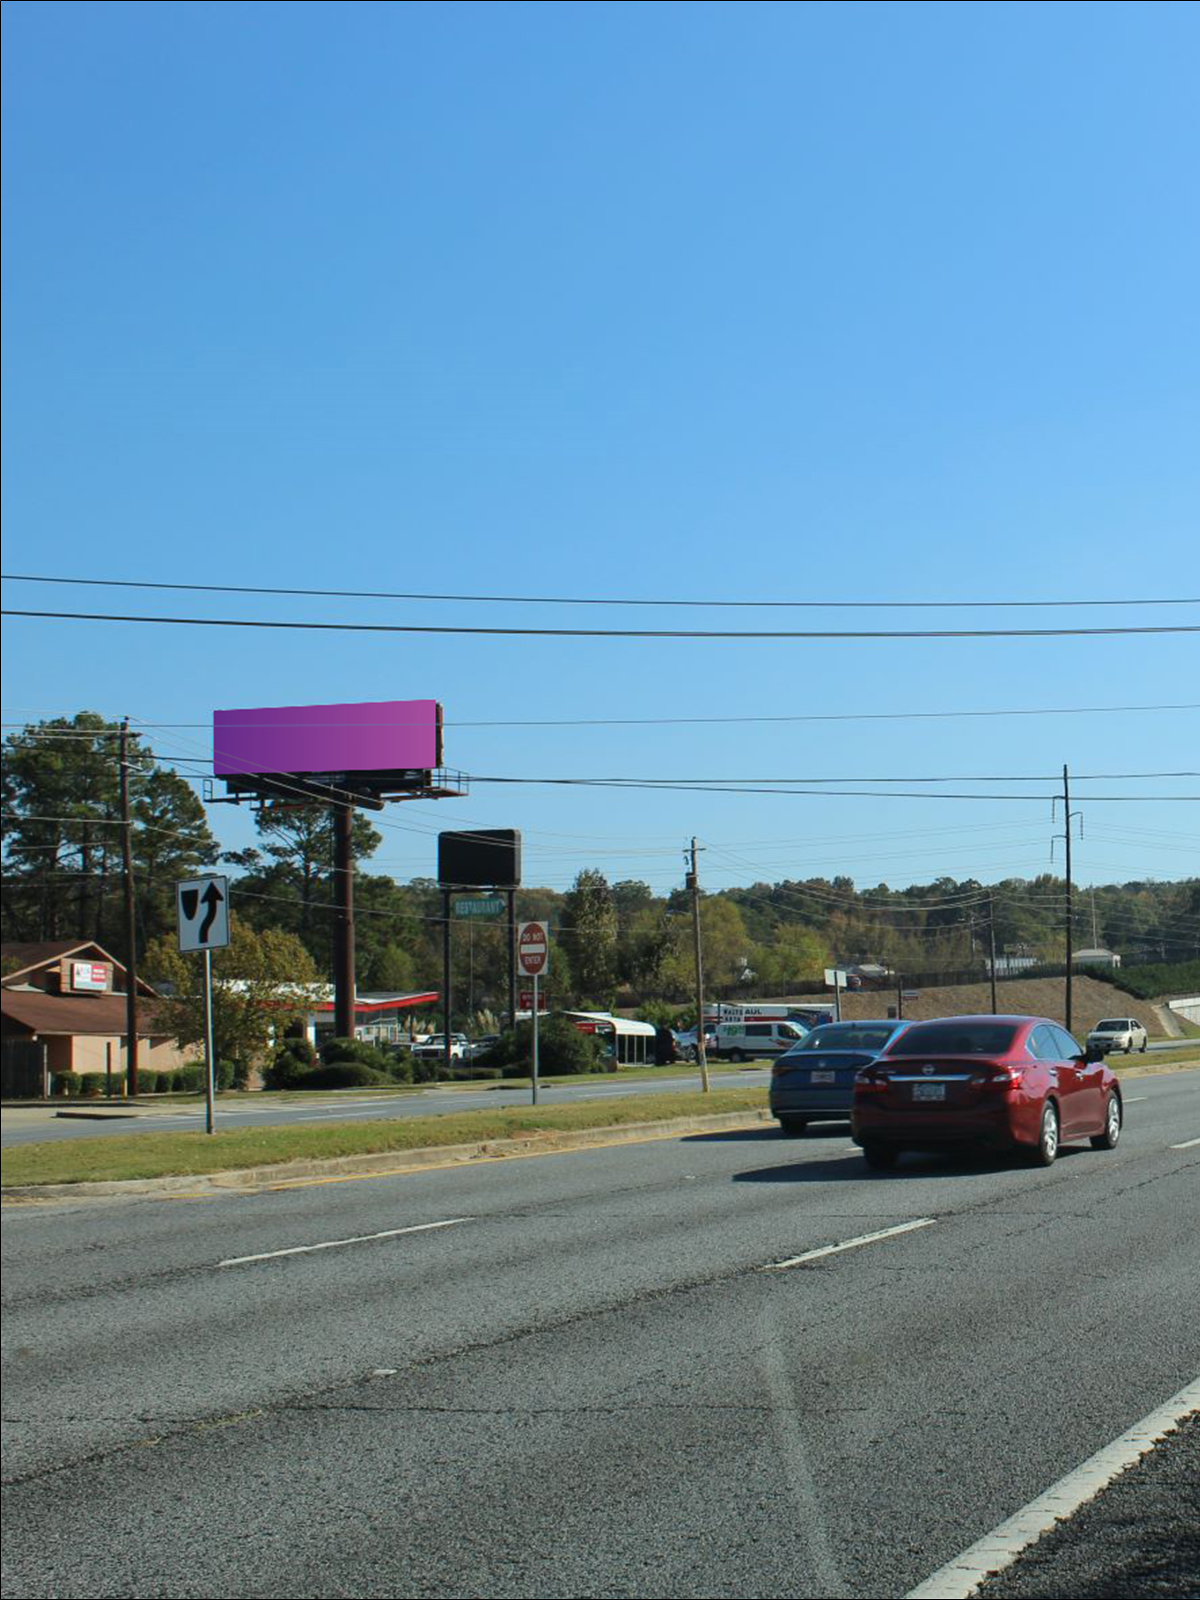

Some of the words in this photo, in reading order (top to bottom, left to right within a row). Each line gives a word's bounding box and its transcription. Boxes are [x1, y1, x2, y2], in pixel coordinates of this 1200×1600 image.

[455, 901, 499, 915] RESTAURANT
[523, 933, 531, 942] DO
[533, 932, 544, 941] NOT
[525, 956, 541, 965] ENTER
